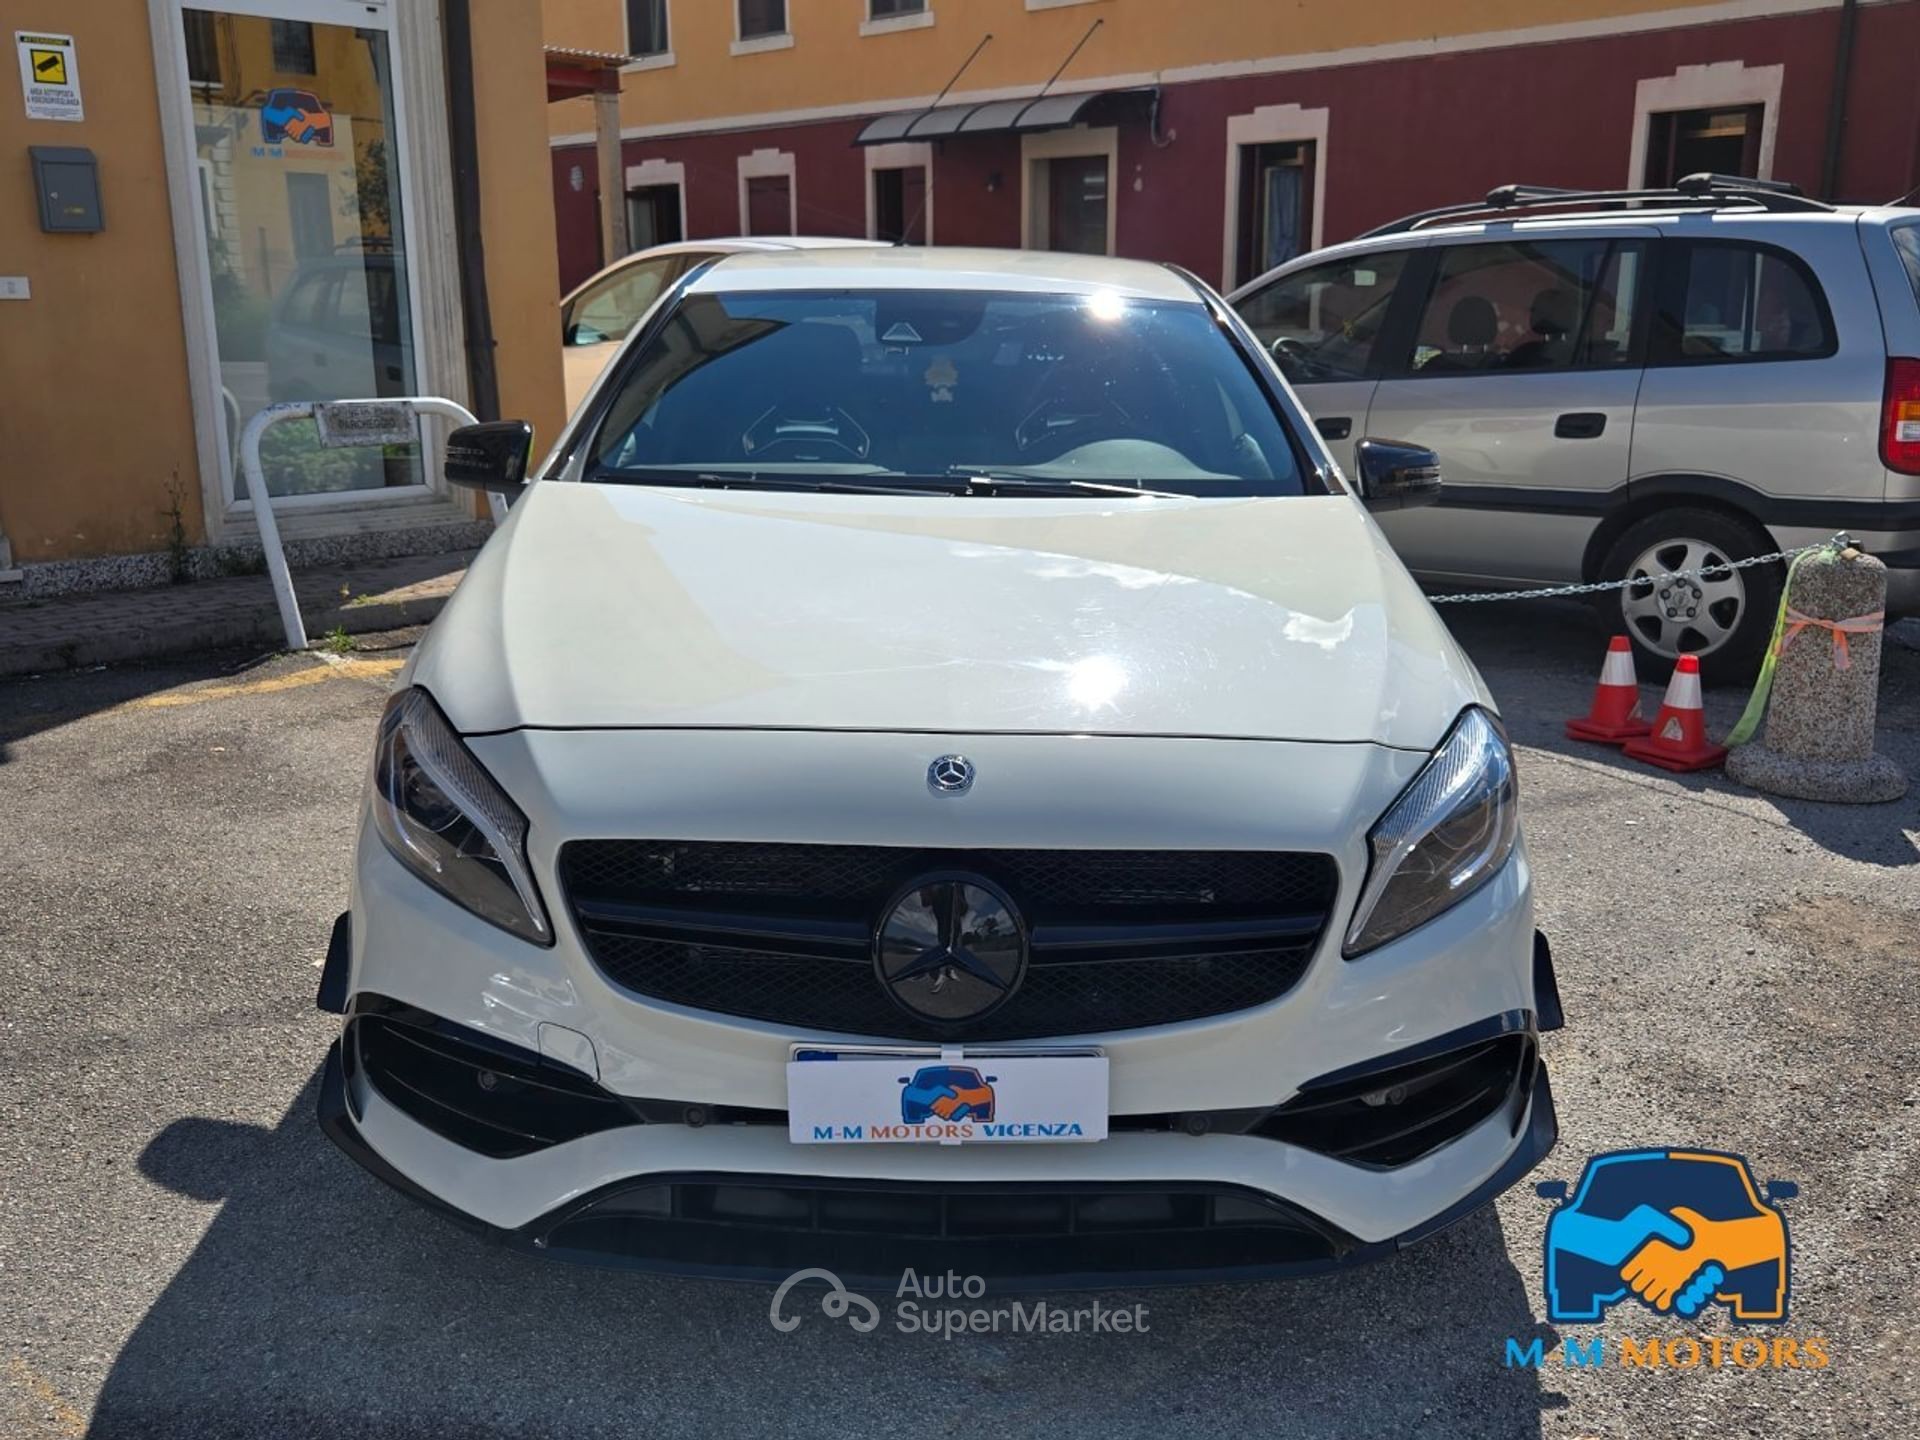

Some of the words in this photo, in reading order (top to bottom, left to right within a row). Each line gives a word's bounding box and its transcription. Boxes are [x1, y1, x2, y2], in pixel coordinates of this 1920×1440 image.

[813, 1125, 862, 1140] M-M
[871, 1124, 973, 1139] MOTORS
[983, 1122, 1083, 1137] VICENZA
